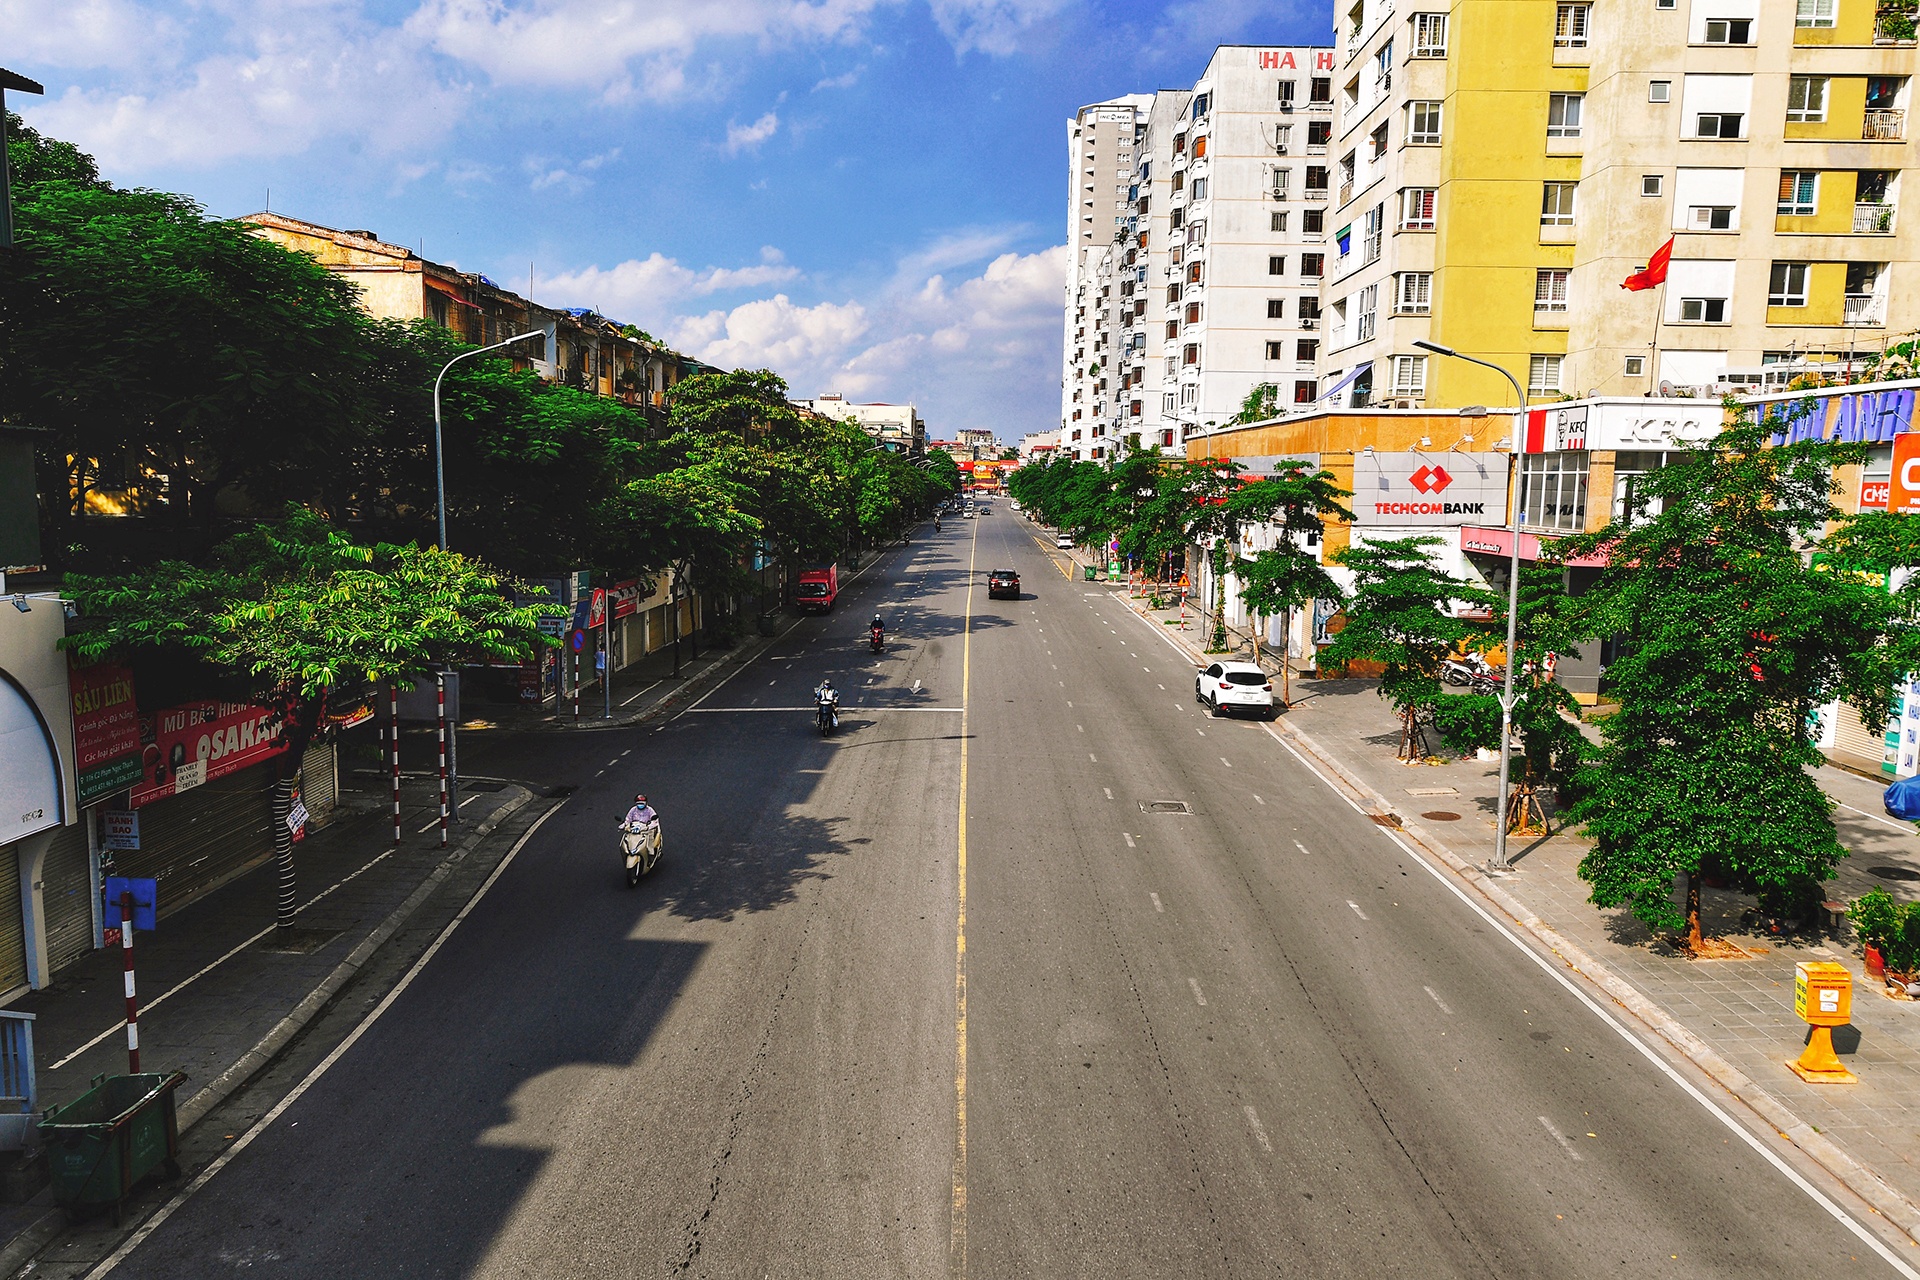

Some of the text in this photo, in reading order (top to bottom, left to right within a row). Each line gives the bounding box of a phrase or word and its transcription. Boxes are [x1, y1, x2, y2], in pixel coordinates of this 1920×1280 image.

[1830, 388, 1915, 443] ANH
[1568, 420, 1586, 434] KFC
[1619, 417, 1701, 444] KFC
[1863, 485, 1889, 503] CMS
[1374, 502, 1485, 515] TECHCOMBANK
[103, 675, 133, 708] LIÊN
[164, 709, 186, 734] MŨ
[84, 752, 97, 763] Các
